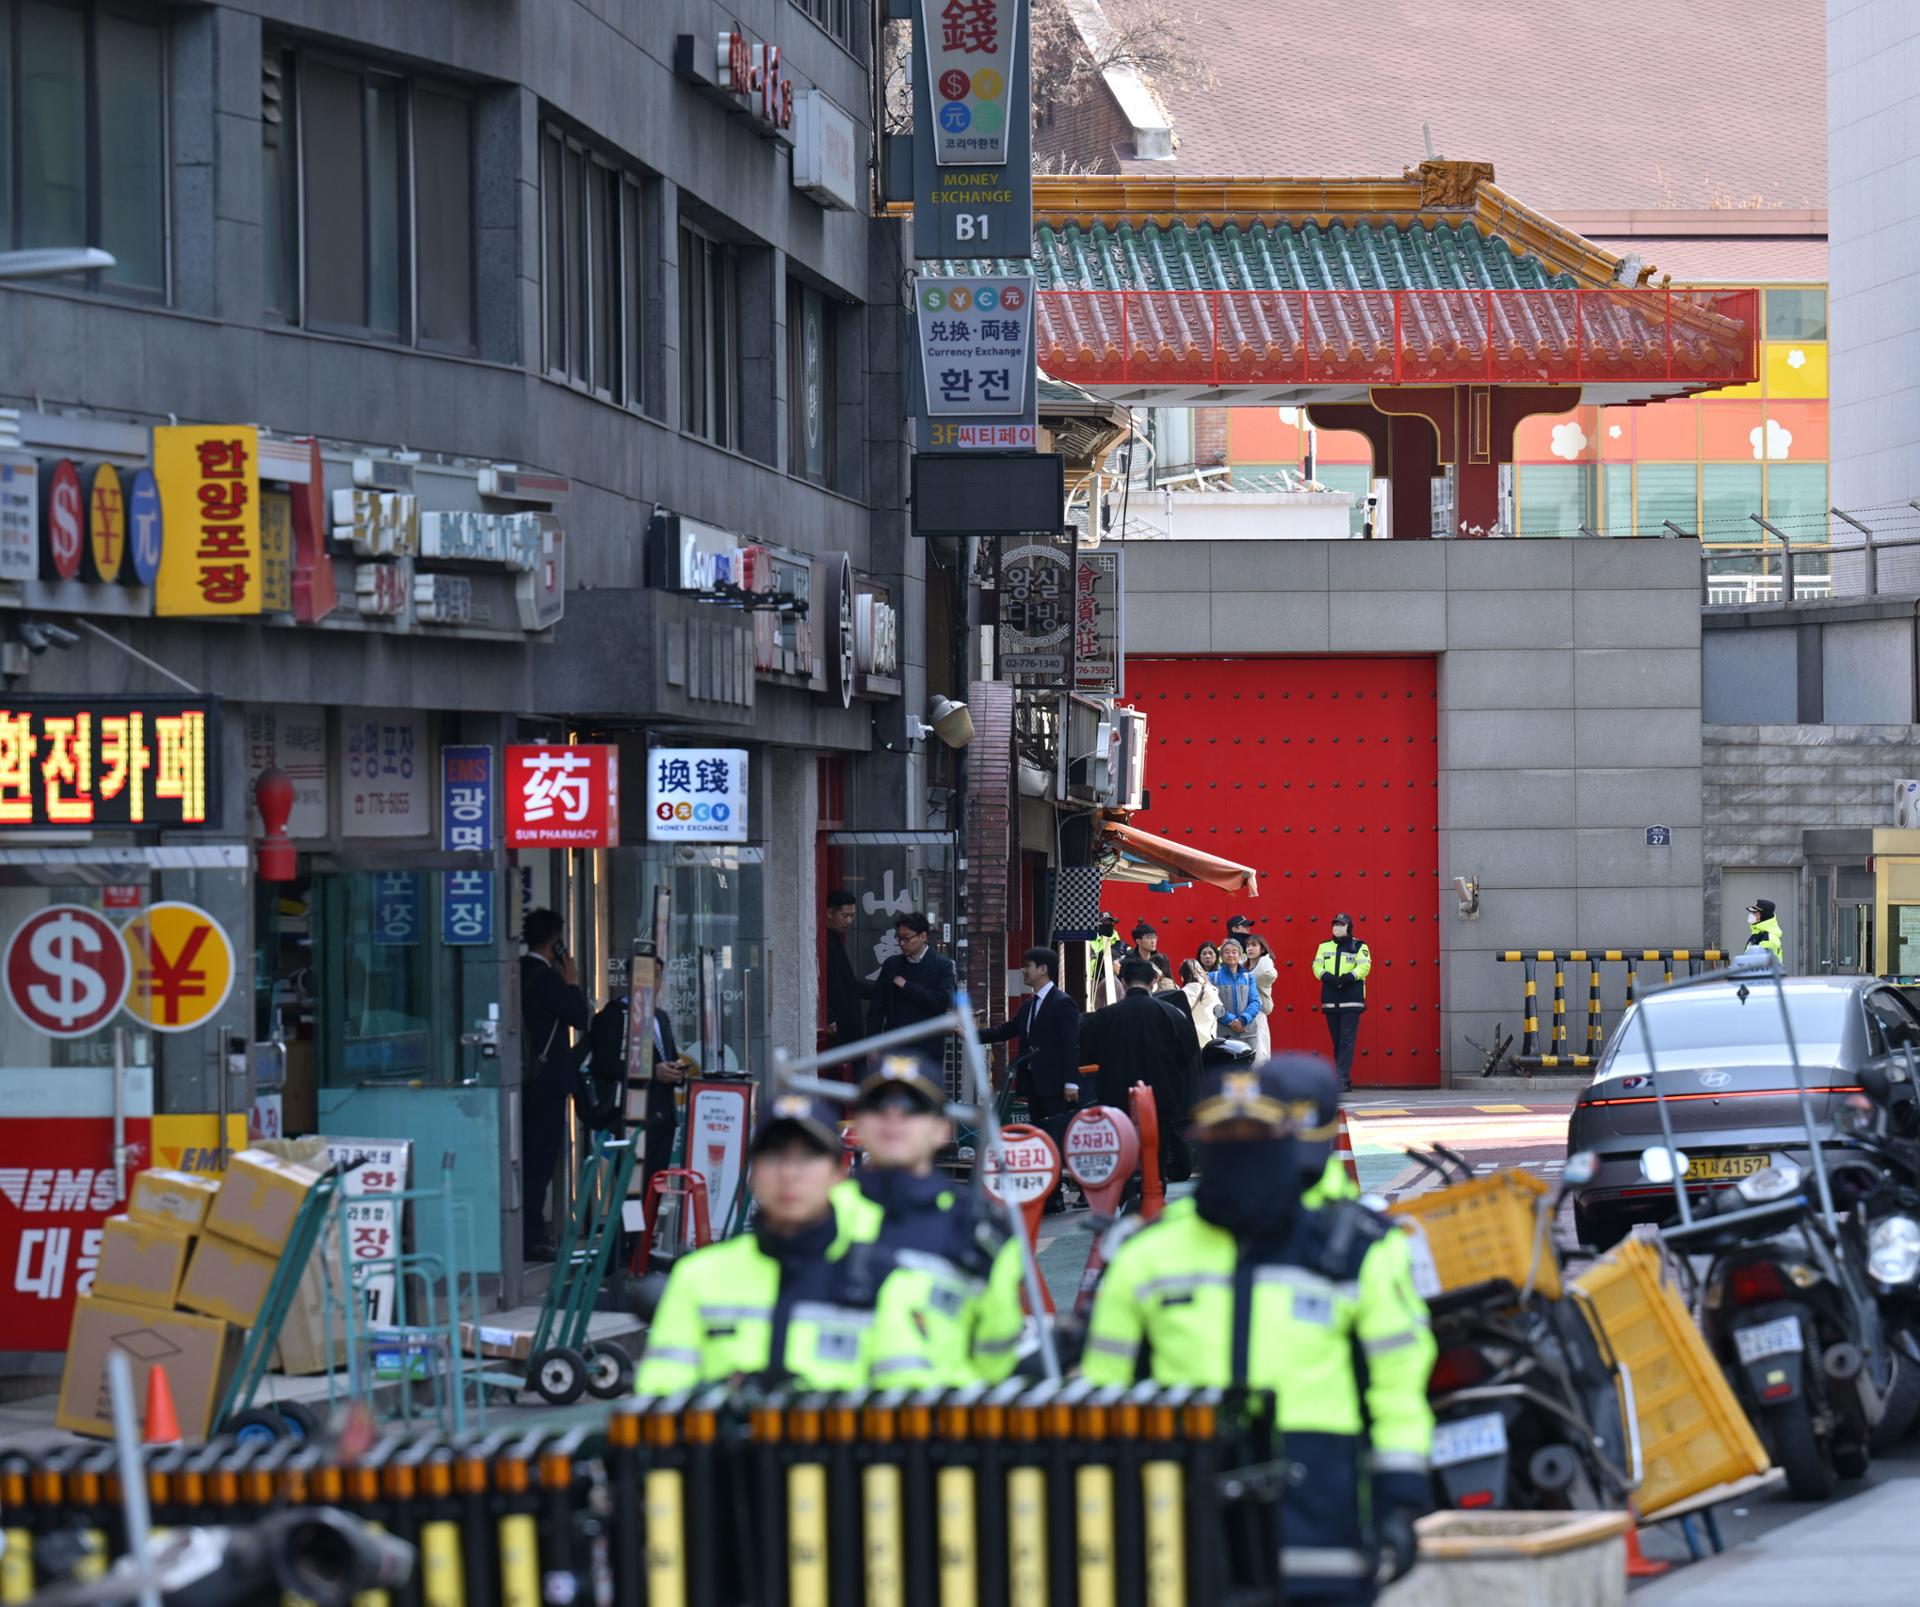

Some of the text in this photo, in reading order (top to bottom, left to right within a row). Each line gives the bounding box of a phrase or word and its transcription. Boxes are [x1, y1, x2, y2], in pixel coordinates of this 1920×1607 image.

[941, 0, 999, 54] 錢
[945, 138, 999, 150] 코리아환전
[943, 174, 998, 186] MONEY
[931, 191, 1012, 203] EXCHANGE
[956, 214, 989, 241] B1
[928, 347, 1022, 359] Currency Exchange
[940, 368, 1010, 402] 환전
[931, 424, 958, 445] 3F
[196, 440, 250, 604] 한양포장
[1007, 568, 1060, 600] 왕실
[1007, 602, 1064, 631] 다방
[1005, 659, 1060, 669] 02-776-1340
[448, 759, 487, 782] EMS
[658, 758, 729, 794] 換錢
[522, 752, 591, 822] 药
[515, 829, 598, 840] SUN PHARMACY
[687, 824, 729, 832] EXCHANGE
[1652, 835, 1664, 844] 27
[23, 1168, 117, 1212] EMS
